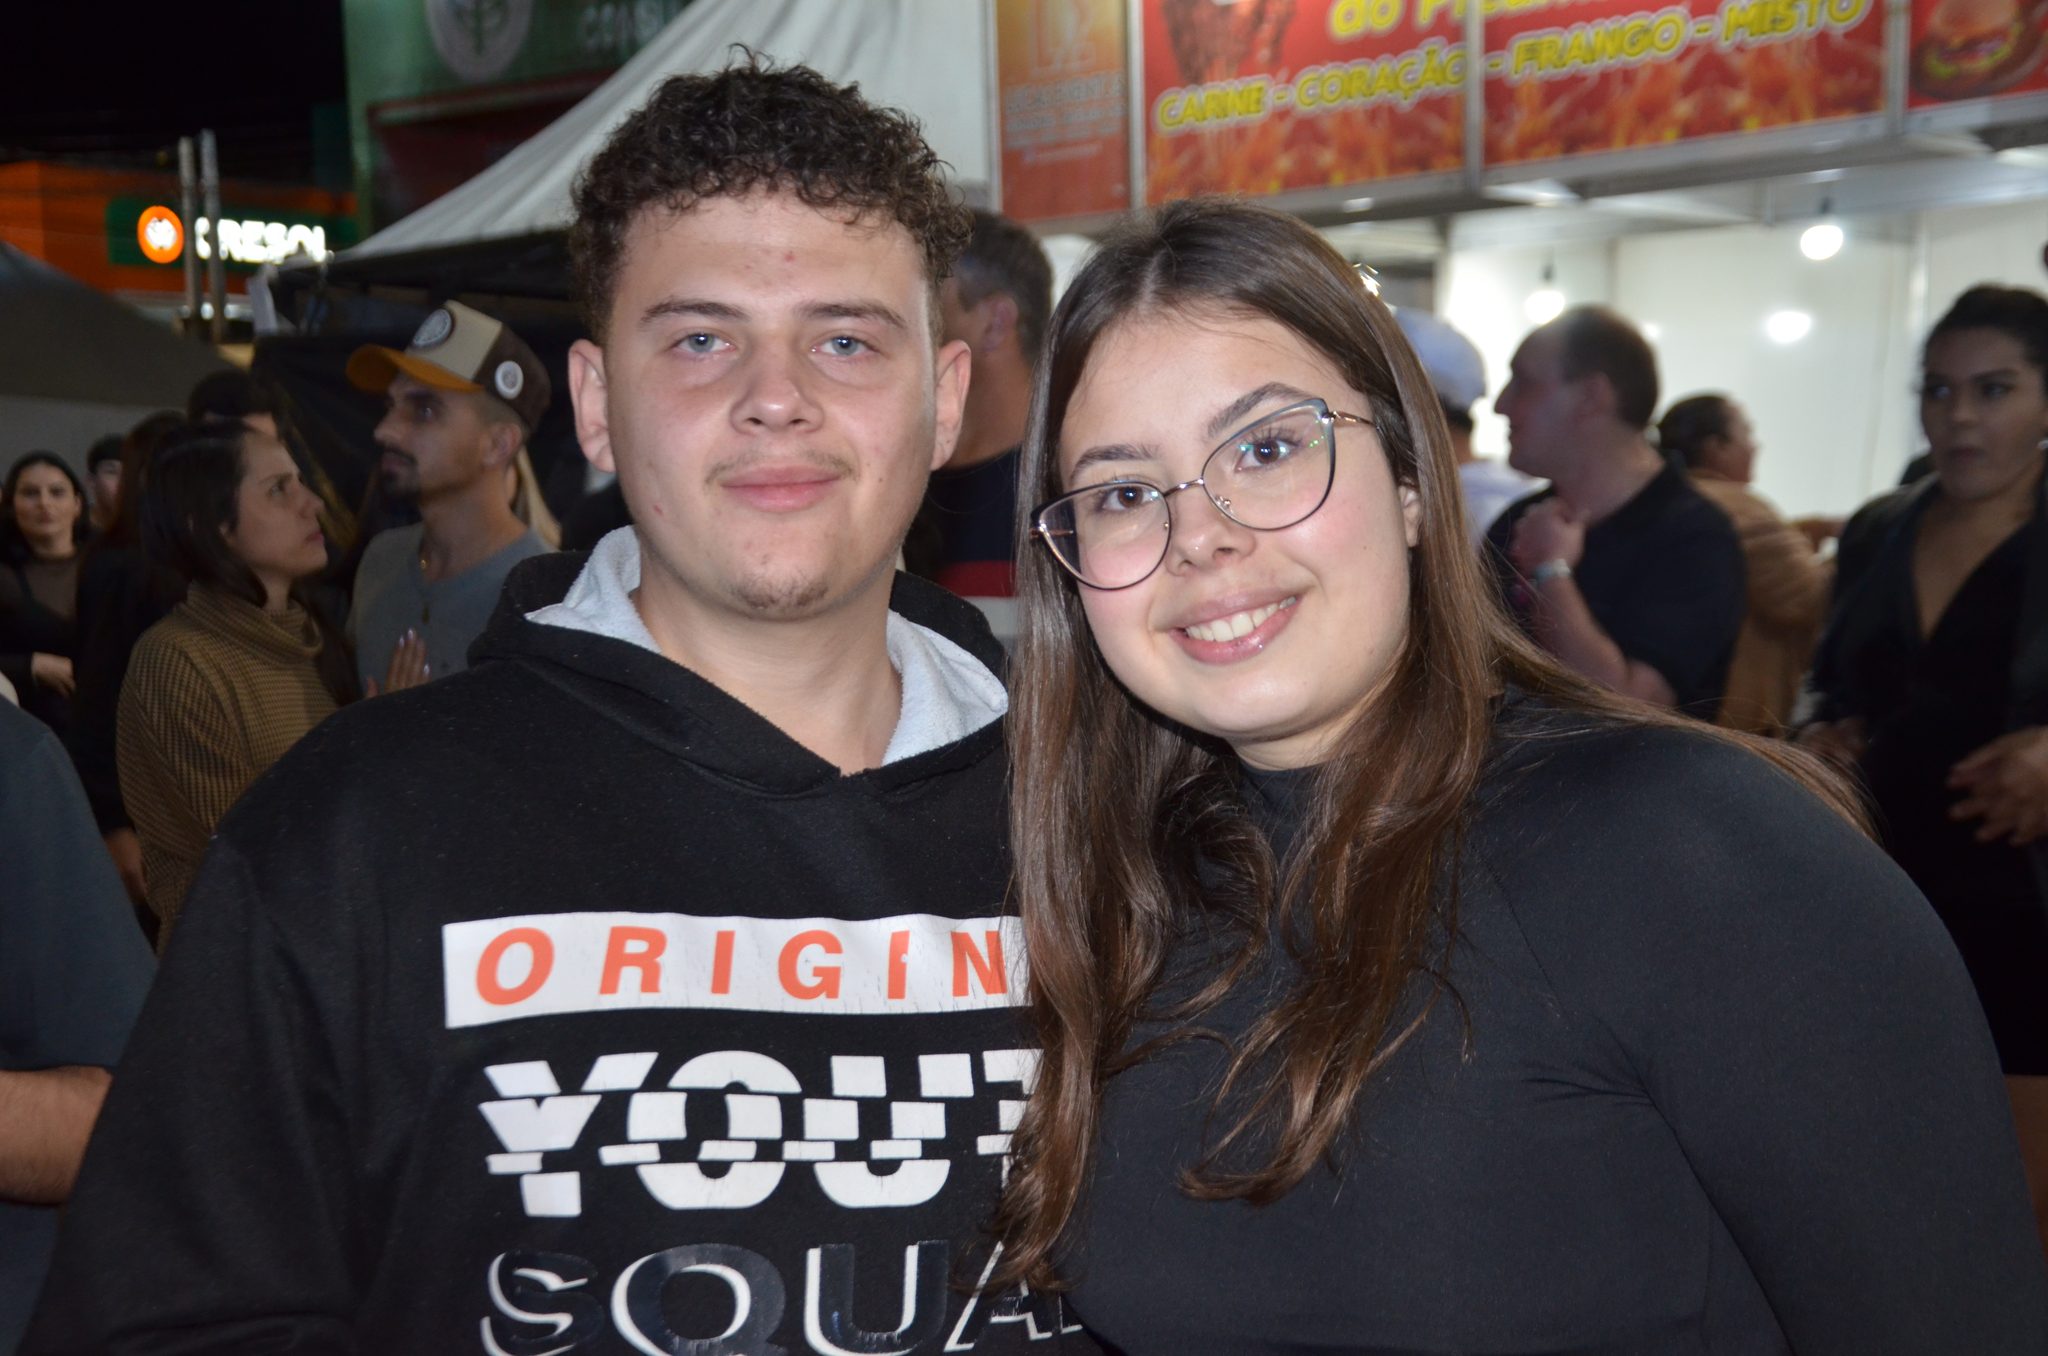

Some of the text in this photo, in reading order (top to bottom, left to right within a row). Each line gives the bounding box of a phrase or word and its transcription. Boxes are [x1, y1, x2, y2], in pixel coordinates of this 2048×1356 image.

[1158, 78, 1269, 130] CARNE
[1298, 43, 1468, 107] CORAÇÃO
[1512, 15, 1685, 77] FRANGO
[475, 926, 1008, 1006] ORIGIN
[480, 1237, 1084, 1356] SQUA
